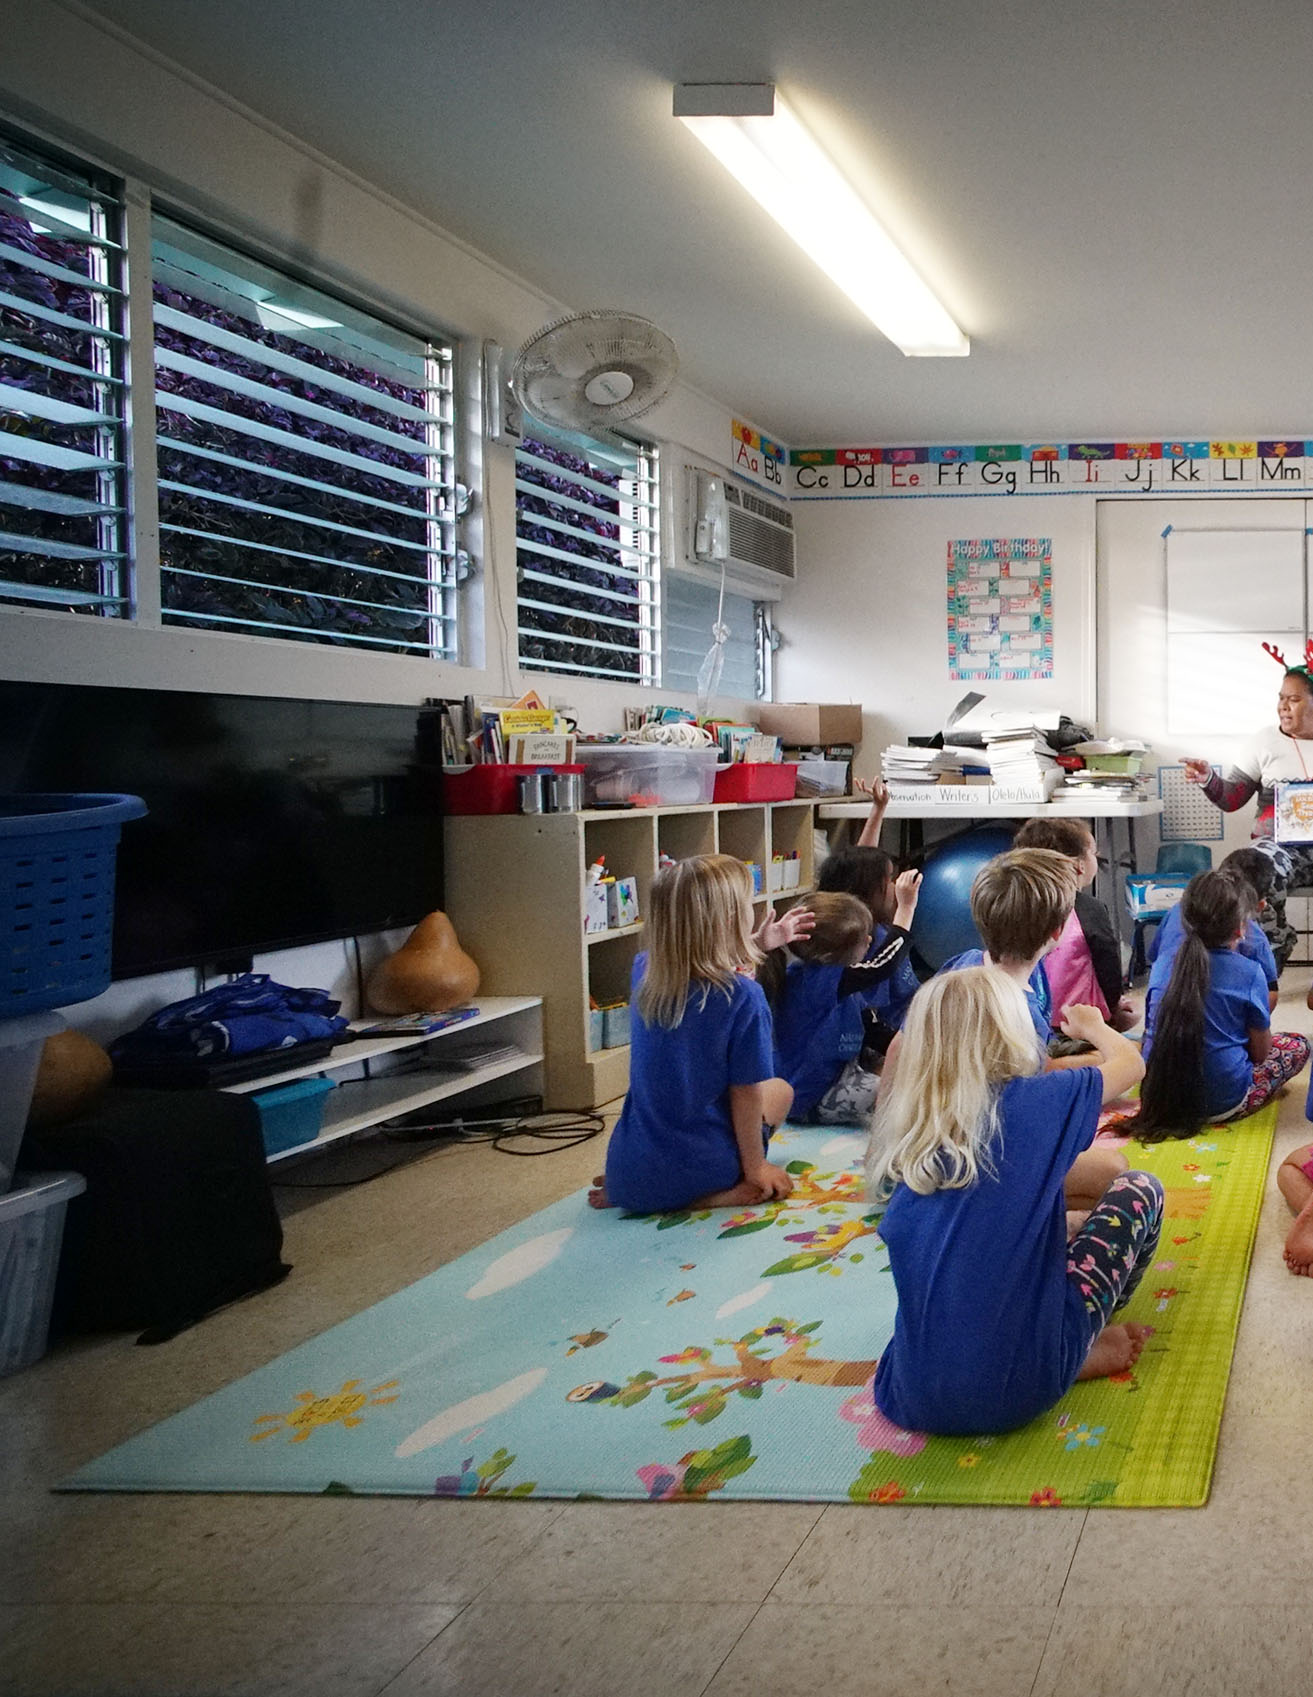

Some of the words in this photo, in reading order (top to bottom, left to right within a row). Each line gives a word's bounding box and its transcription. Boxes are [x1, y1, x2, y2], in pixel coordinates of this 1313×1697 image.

[737, 442, 758, 473] Aa
[764, 455, 782, 485] Bb
[796, 465, 829, 488] Cc
[844, 465, 875, 487] Dd
[891, 464, 919, 487] Ee
[938, 462, 964, 485] Ff
[981, 461, 1016, 494] Gg
[1030, 460, 1060, 484] Hh
[1086, 459, 1099, 482] Ii
[1125, 459, 1153, 491] Jj
[1171, 458, 1200, 482] Kk
[1223, 458, 1244, 481] Ll
[1261, 456, 1301, 480] Mm
[952, 542, 990, 557] Happy
[993, 541, 1048, 555] Birthday!
[939, 788, 979, 802] Writers
